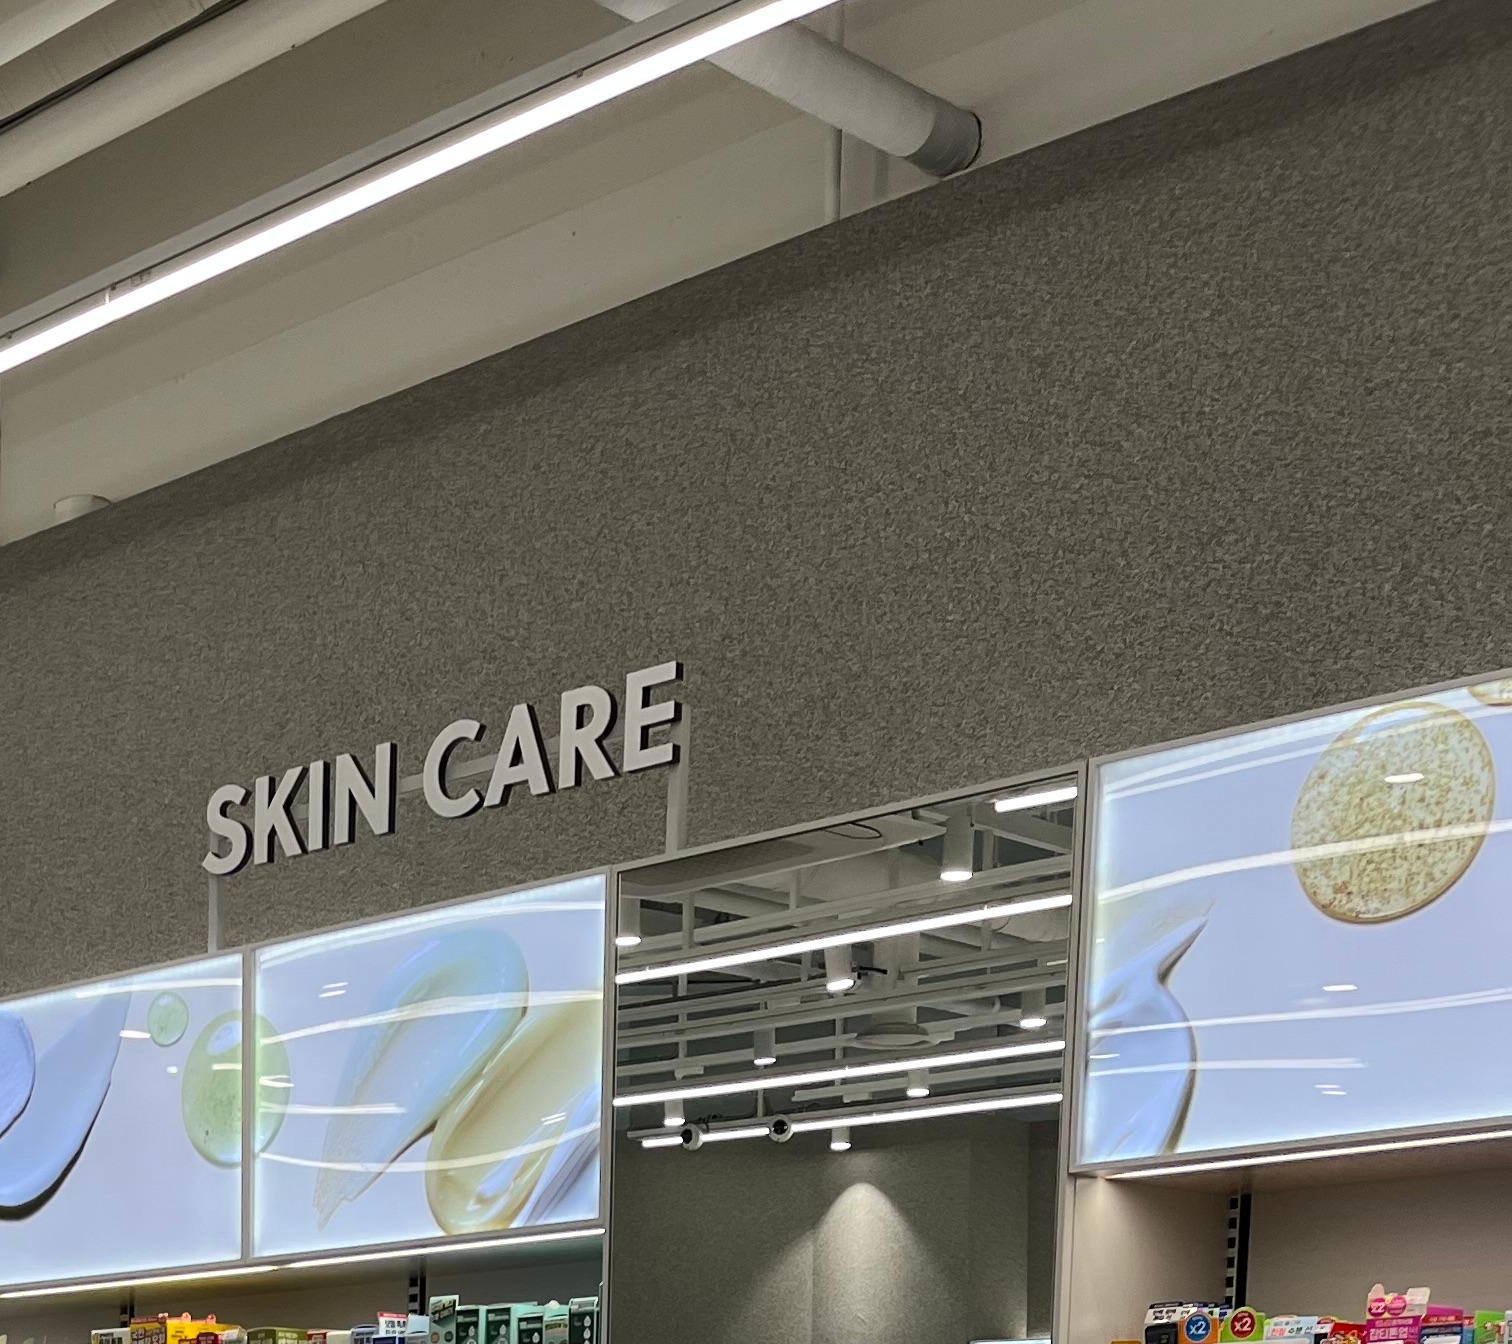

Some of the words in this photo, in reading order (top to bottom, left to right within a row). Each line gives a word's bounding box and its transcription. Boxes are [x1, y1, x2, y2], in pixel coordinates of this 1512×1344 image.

[202, 741, 397, 875] SKIN
[423, 660, 683, 818] CARE
[1189, 1320, 1207, 1335] x2
[1235, 1317, 1252, 1333] x2
